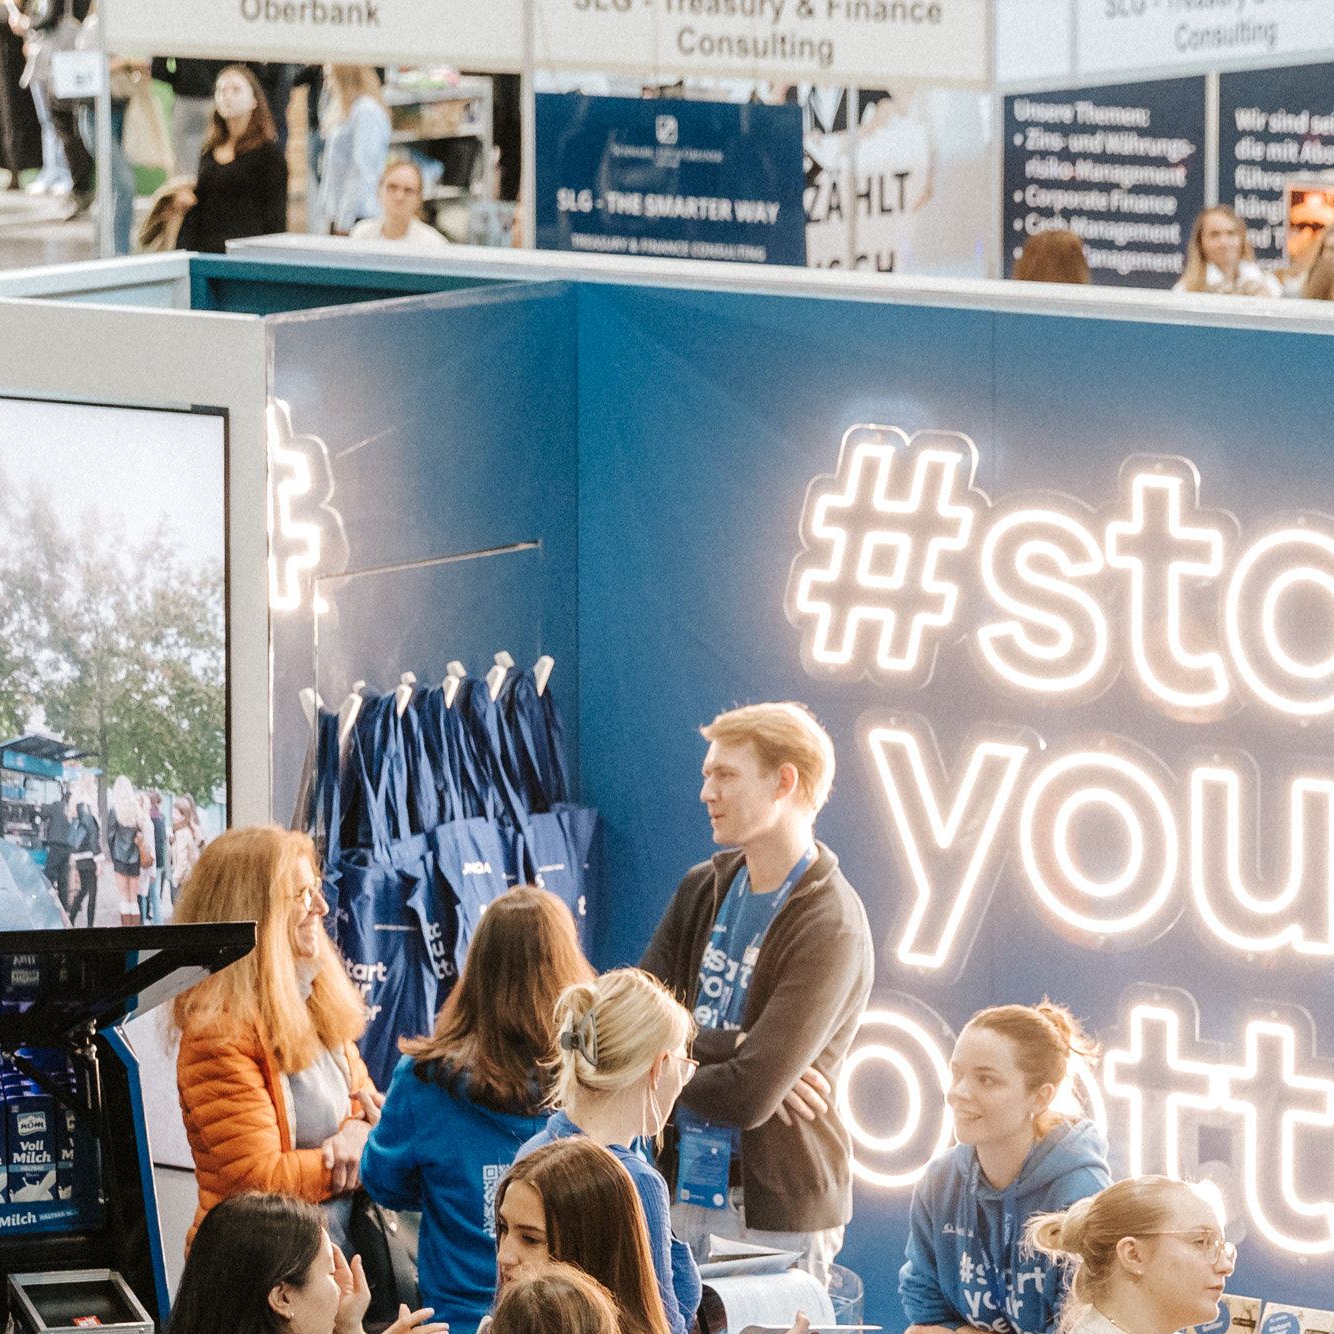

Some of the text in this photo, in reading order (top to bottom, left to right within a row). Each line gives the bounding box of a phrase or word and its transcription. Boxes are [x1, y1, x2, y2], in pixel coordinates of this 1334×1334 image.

[240, 0, 381, 26] Oberbank
[826, 0, 943, 24] Finance
[676, 27, 836, 69] Consulting
[1173, 19, 1280, 51] Consulting
[1014, 98, 1074, 124] Unsere
[1234, 107, 1267, 132] Wir
[1267, 108, 1310, 135] sind
[1068, 129, 1105, 154] und
[1234, 135, 1266, 161] die
[1266, 138, 1299, 164] mit
[556, 187, 593, 213] SLG
[605, 190, 644, 216] THE
[643, 193, 733, 221] SMARTER
[733, 199, 781, 226] WAY
[1024, 183, 1178, 217] Corporate Finance
[1082, 244, 1185, 275] anagement
[12, 1150, 52, 1164] Milch
[19, 1140, 44, 1151] Voll
